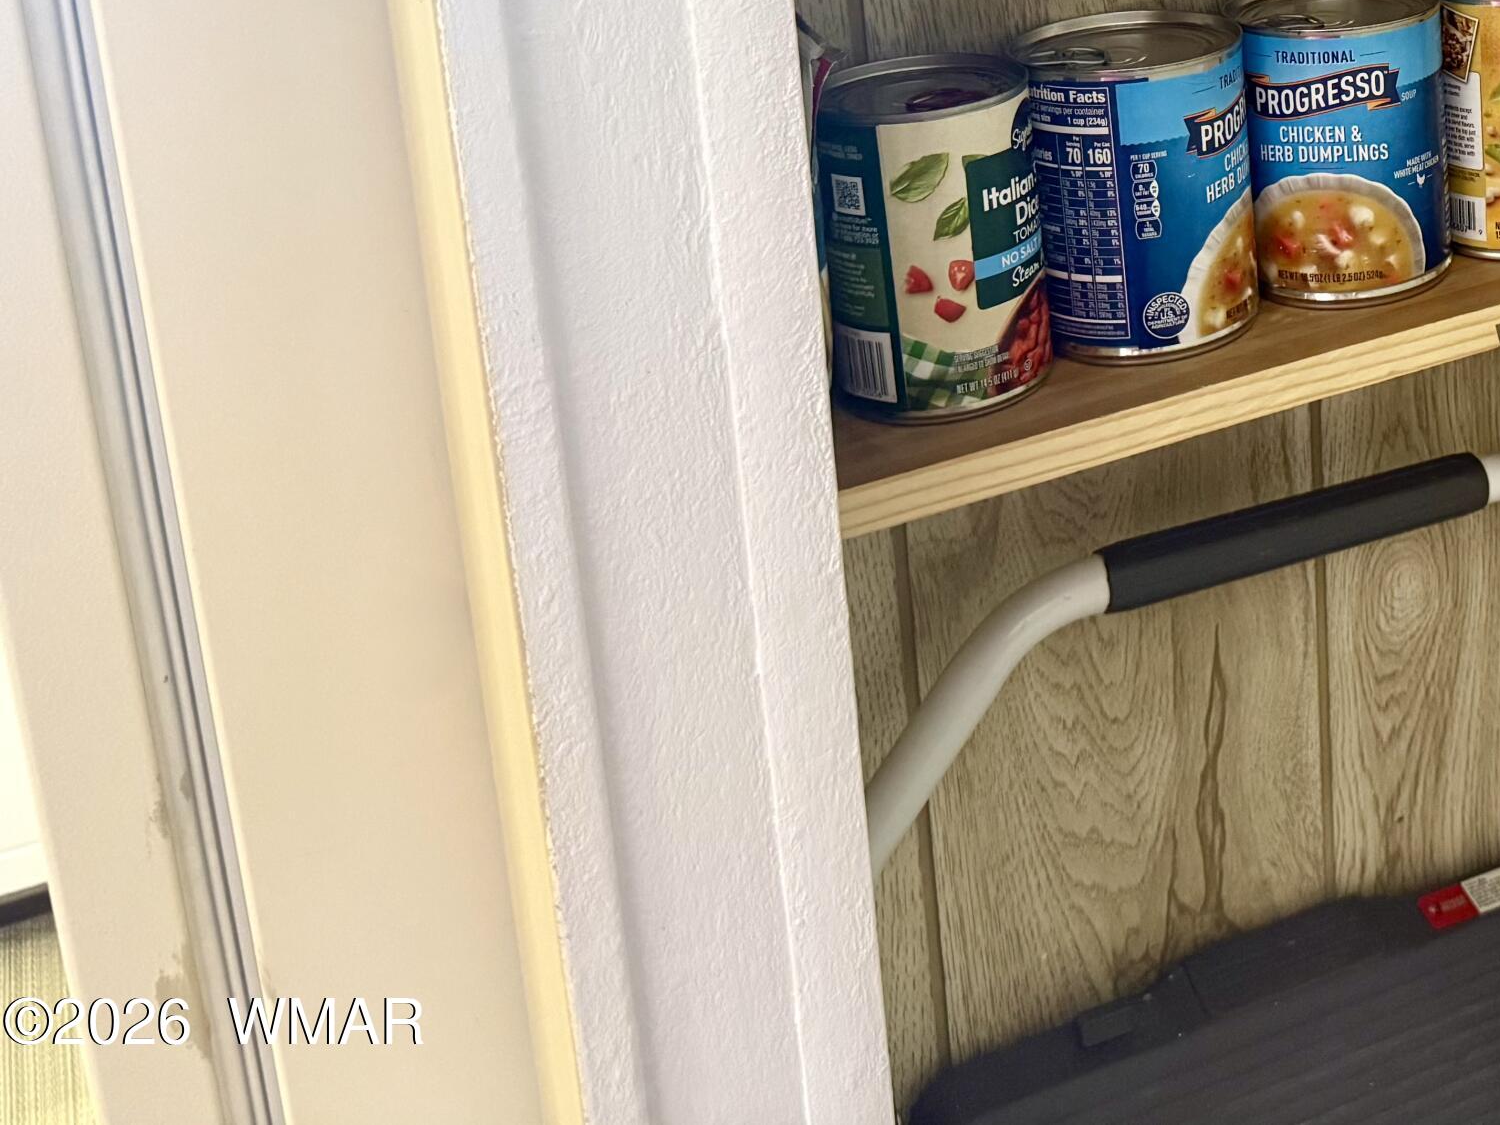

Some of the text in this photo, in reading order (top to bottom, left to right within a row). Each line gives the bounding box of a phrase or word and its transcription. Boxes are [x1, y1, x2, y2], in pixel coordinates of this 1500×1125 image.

[1274, 50, 1356, 64] TRADITIONAL
[1069, 90, 1106, 103] Facts
[1255, 70, 1385, 115] PROGRESSO
[1401, 89, 1417, 101] SOUP
[1072, 117, 1108, 127] cup (234g)
[1279, 125, 1362, 143] CHICKEN &
[1065, 147, 1112, 165] 70 160
[1260, 143, 1389, 165] HERB DUMPLINGS
[1406, 155, 1420, 167] MADE
[1137, 163, 1150, 173] 70
[1412, 162, 1424, 173] MEAT
[982, 172, 1035, 212] Italian
[1206, 174, 1235, 203] HERB
[1001, 237, 1040, 267] NO SALT
[1146, 294, 1187, 317] INSPECTED
